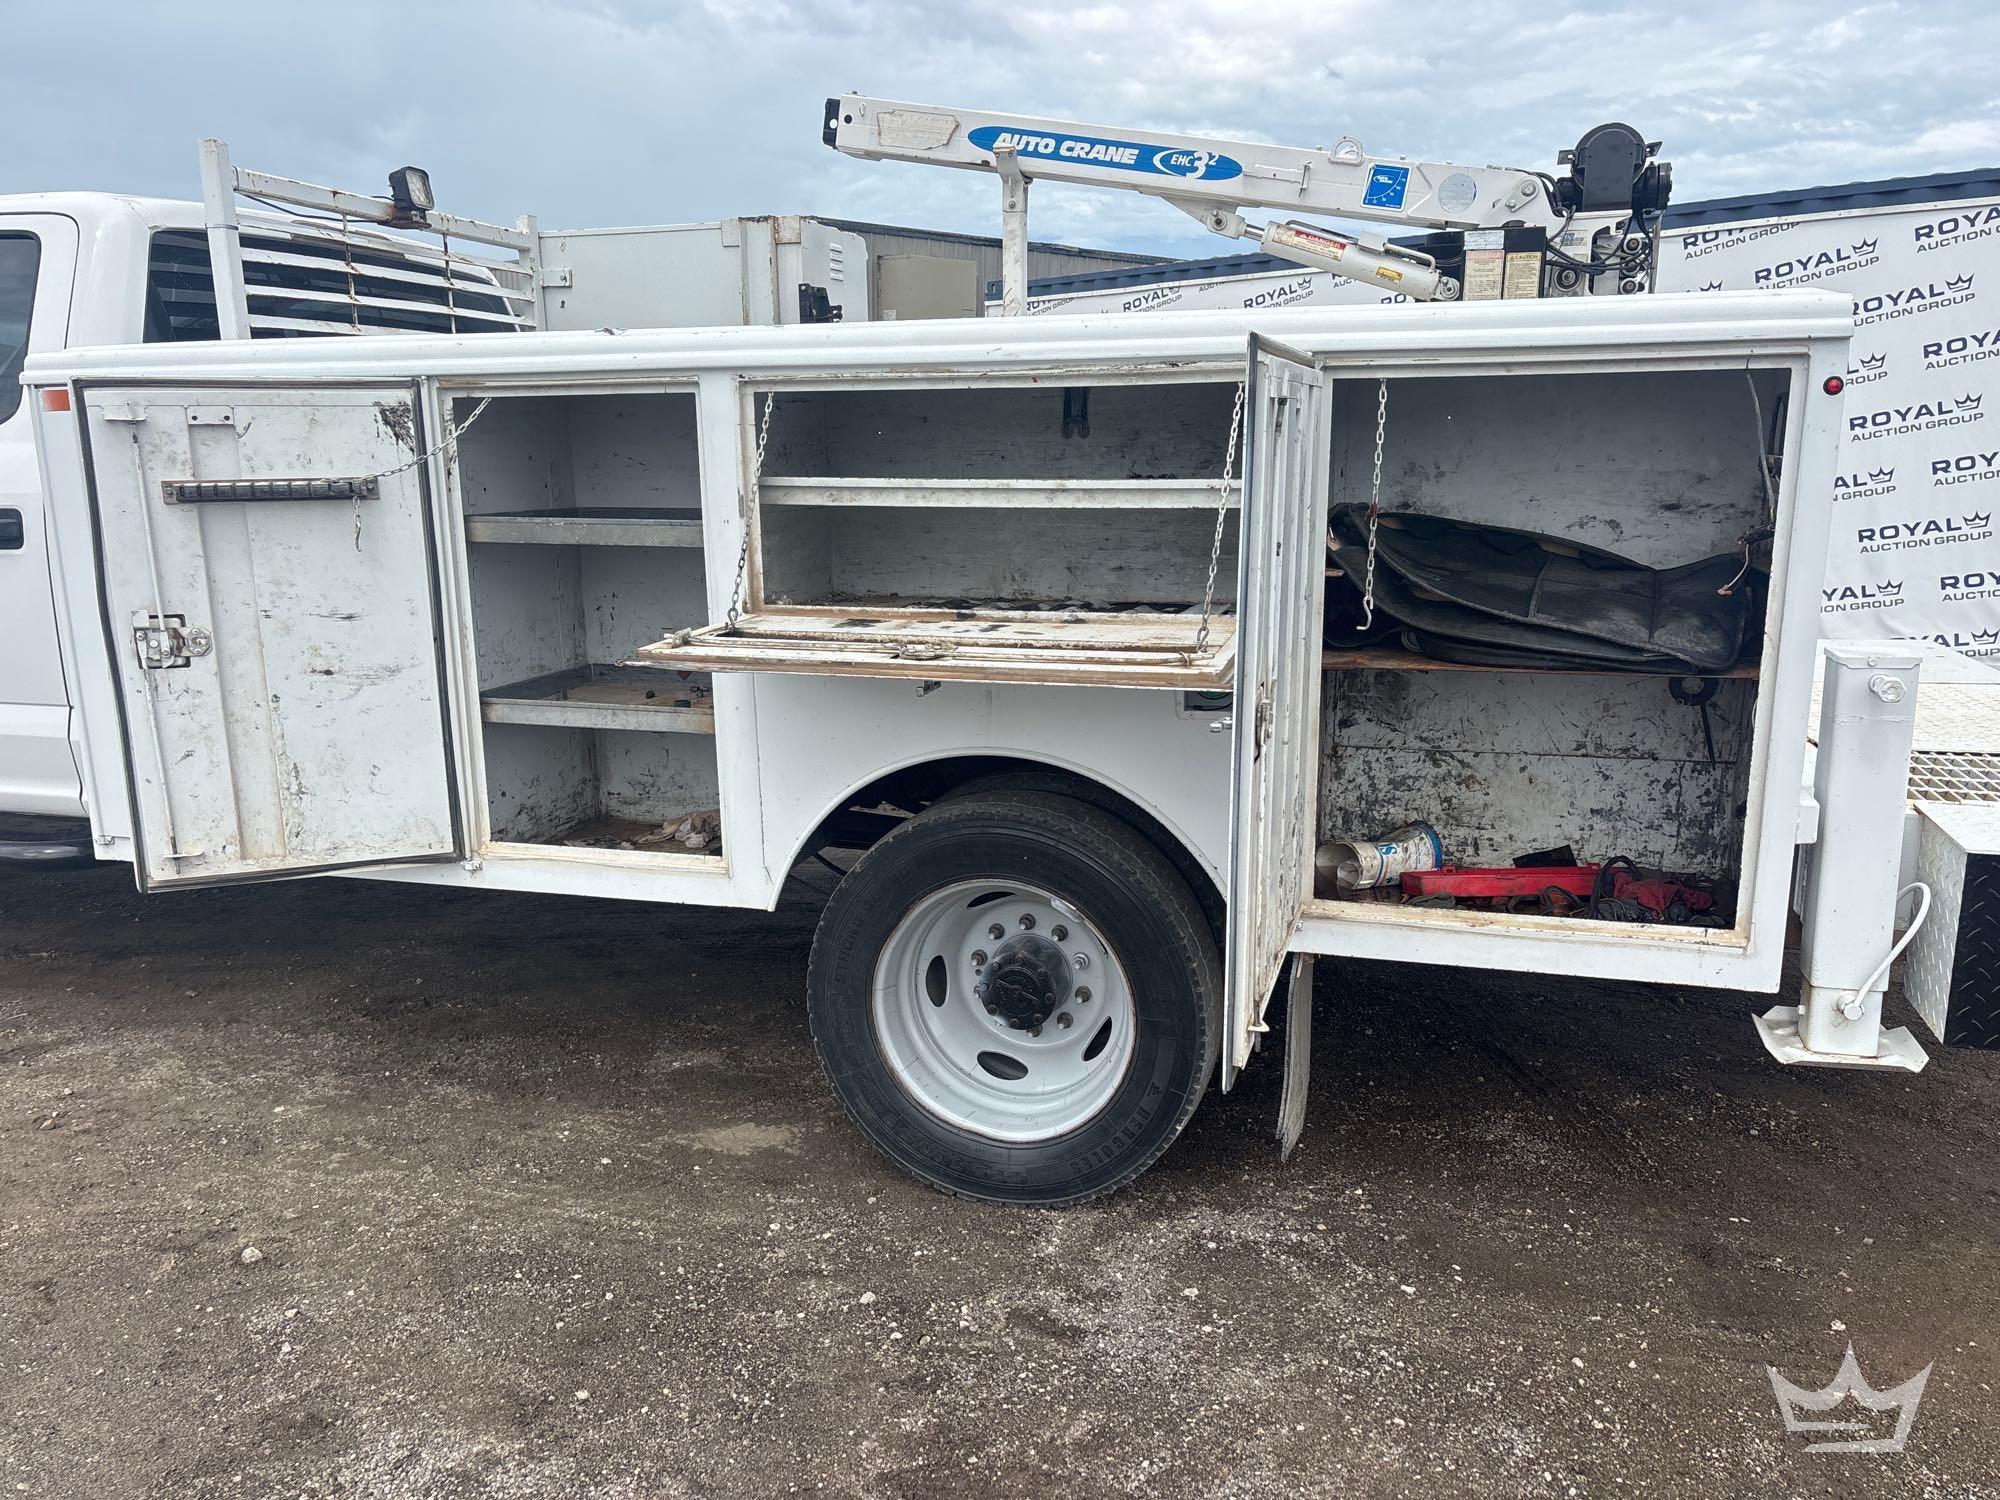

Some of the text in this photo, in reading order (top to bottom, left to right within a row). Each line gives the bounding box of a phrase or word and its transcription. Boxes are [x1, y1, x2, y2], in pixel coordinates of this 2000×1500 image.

[994, 132, 1139, 165] AUTO CRANE
[1915, 207, 2000, 242] ROYA
[1685, 222, 1800, 260] AUCTION GROUP
[1917, 227, 1992, 253] AUCTION
[1754, 248, 1851, 284] ROYAL
[1825, 256, 1880, 277] GROUP
[1123, 287, 1168, 312] ROYAL
[1156, 294, 1182, 308] GROUP
[1244, 284, 1297, 308] ROYAL
[1283, 290, 1314, 305] GROUP
[1854, 292, 1976, 327] UCTION GROUP
[1925, 348, 2000, 370] AUCTION
[1845, 371, 1888, 387] ROUP
[1849, 401, 1953, 431] ROYAL
[1851, 412, 1984, 443] AUCTION GROUP
[1932, 451, 2000, 475] ROY
[1842, 485, 1896, 501] GROUP
[1858, 518, 1962, 543] ROYAL
[1860, 531, 1993, 554] AUCTION GROUP
[1823, 585, 1876, 601] YAL
[1940, 571, 2000, 591] ROY
[1850, 598, 1904, 611] GROUP
[1956, 648, 2000, 658] OUP
[1069, 1106, 1152, 1175] HERCULES
